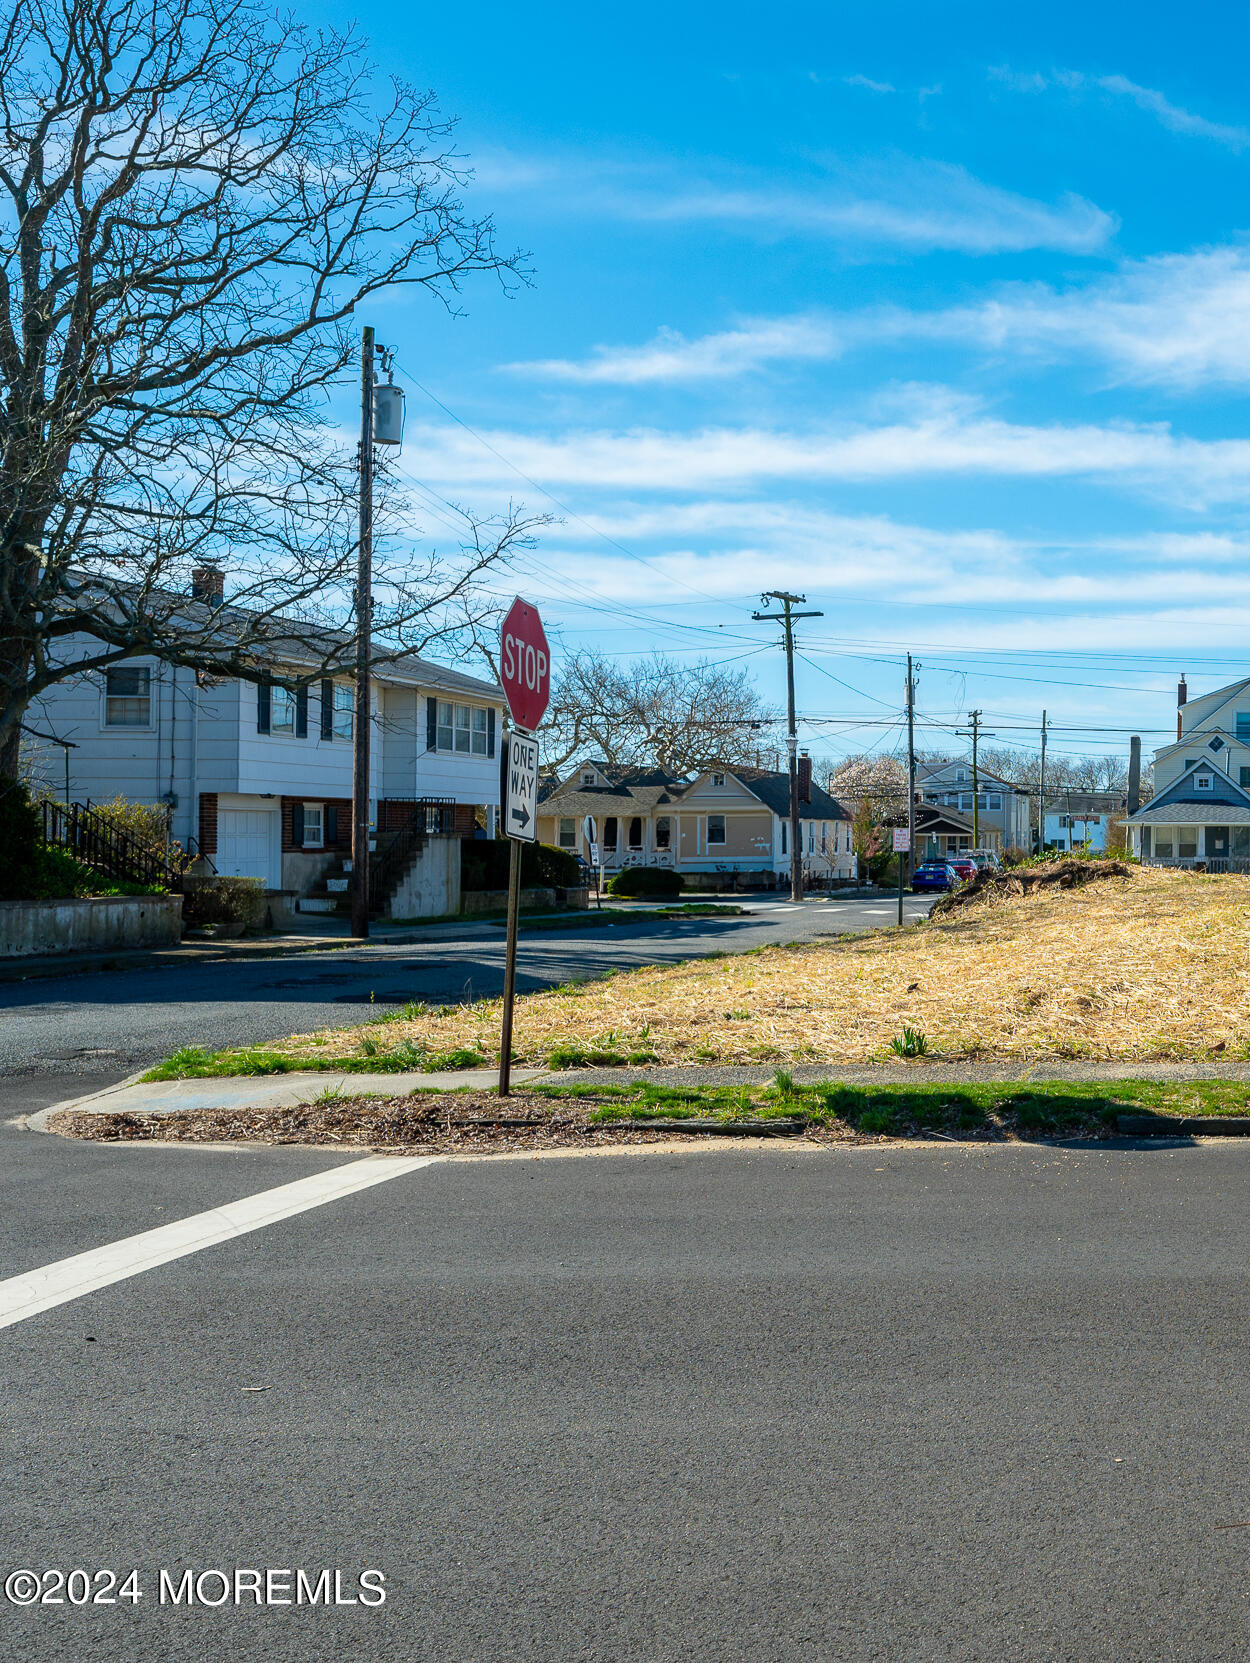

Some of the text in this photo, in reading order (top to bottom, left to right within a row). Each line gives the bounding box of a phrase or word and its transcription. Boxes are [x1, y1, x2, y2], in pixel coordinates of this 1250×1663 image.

[504, 633, 547, 694] STOP
[513, 742, 535, 771] ONE
[511, 770, 535, 799] WAY
